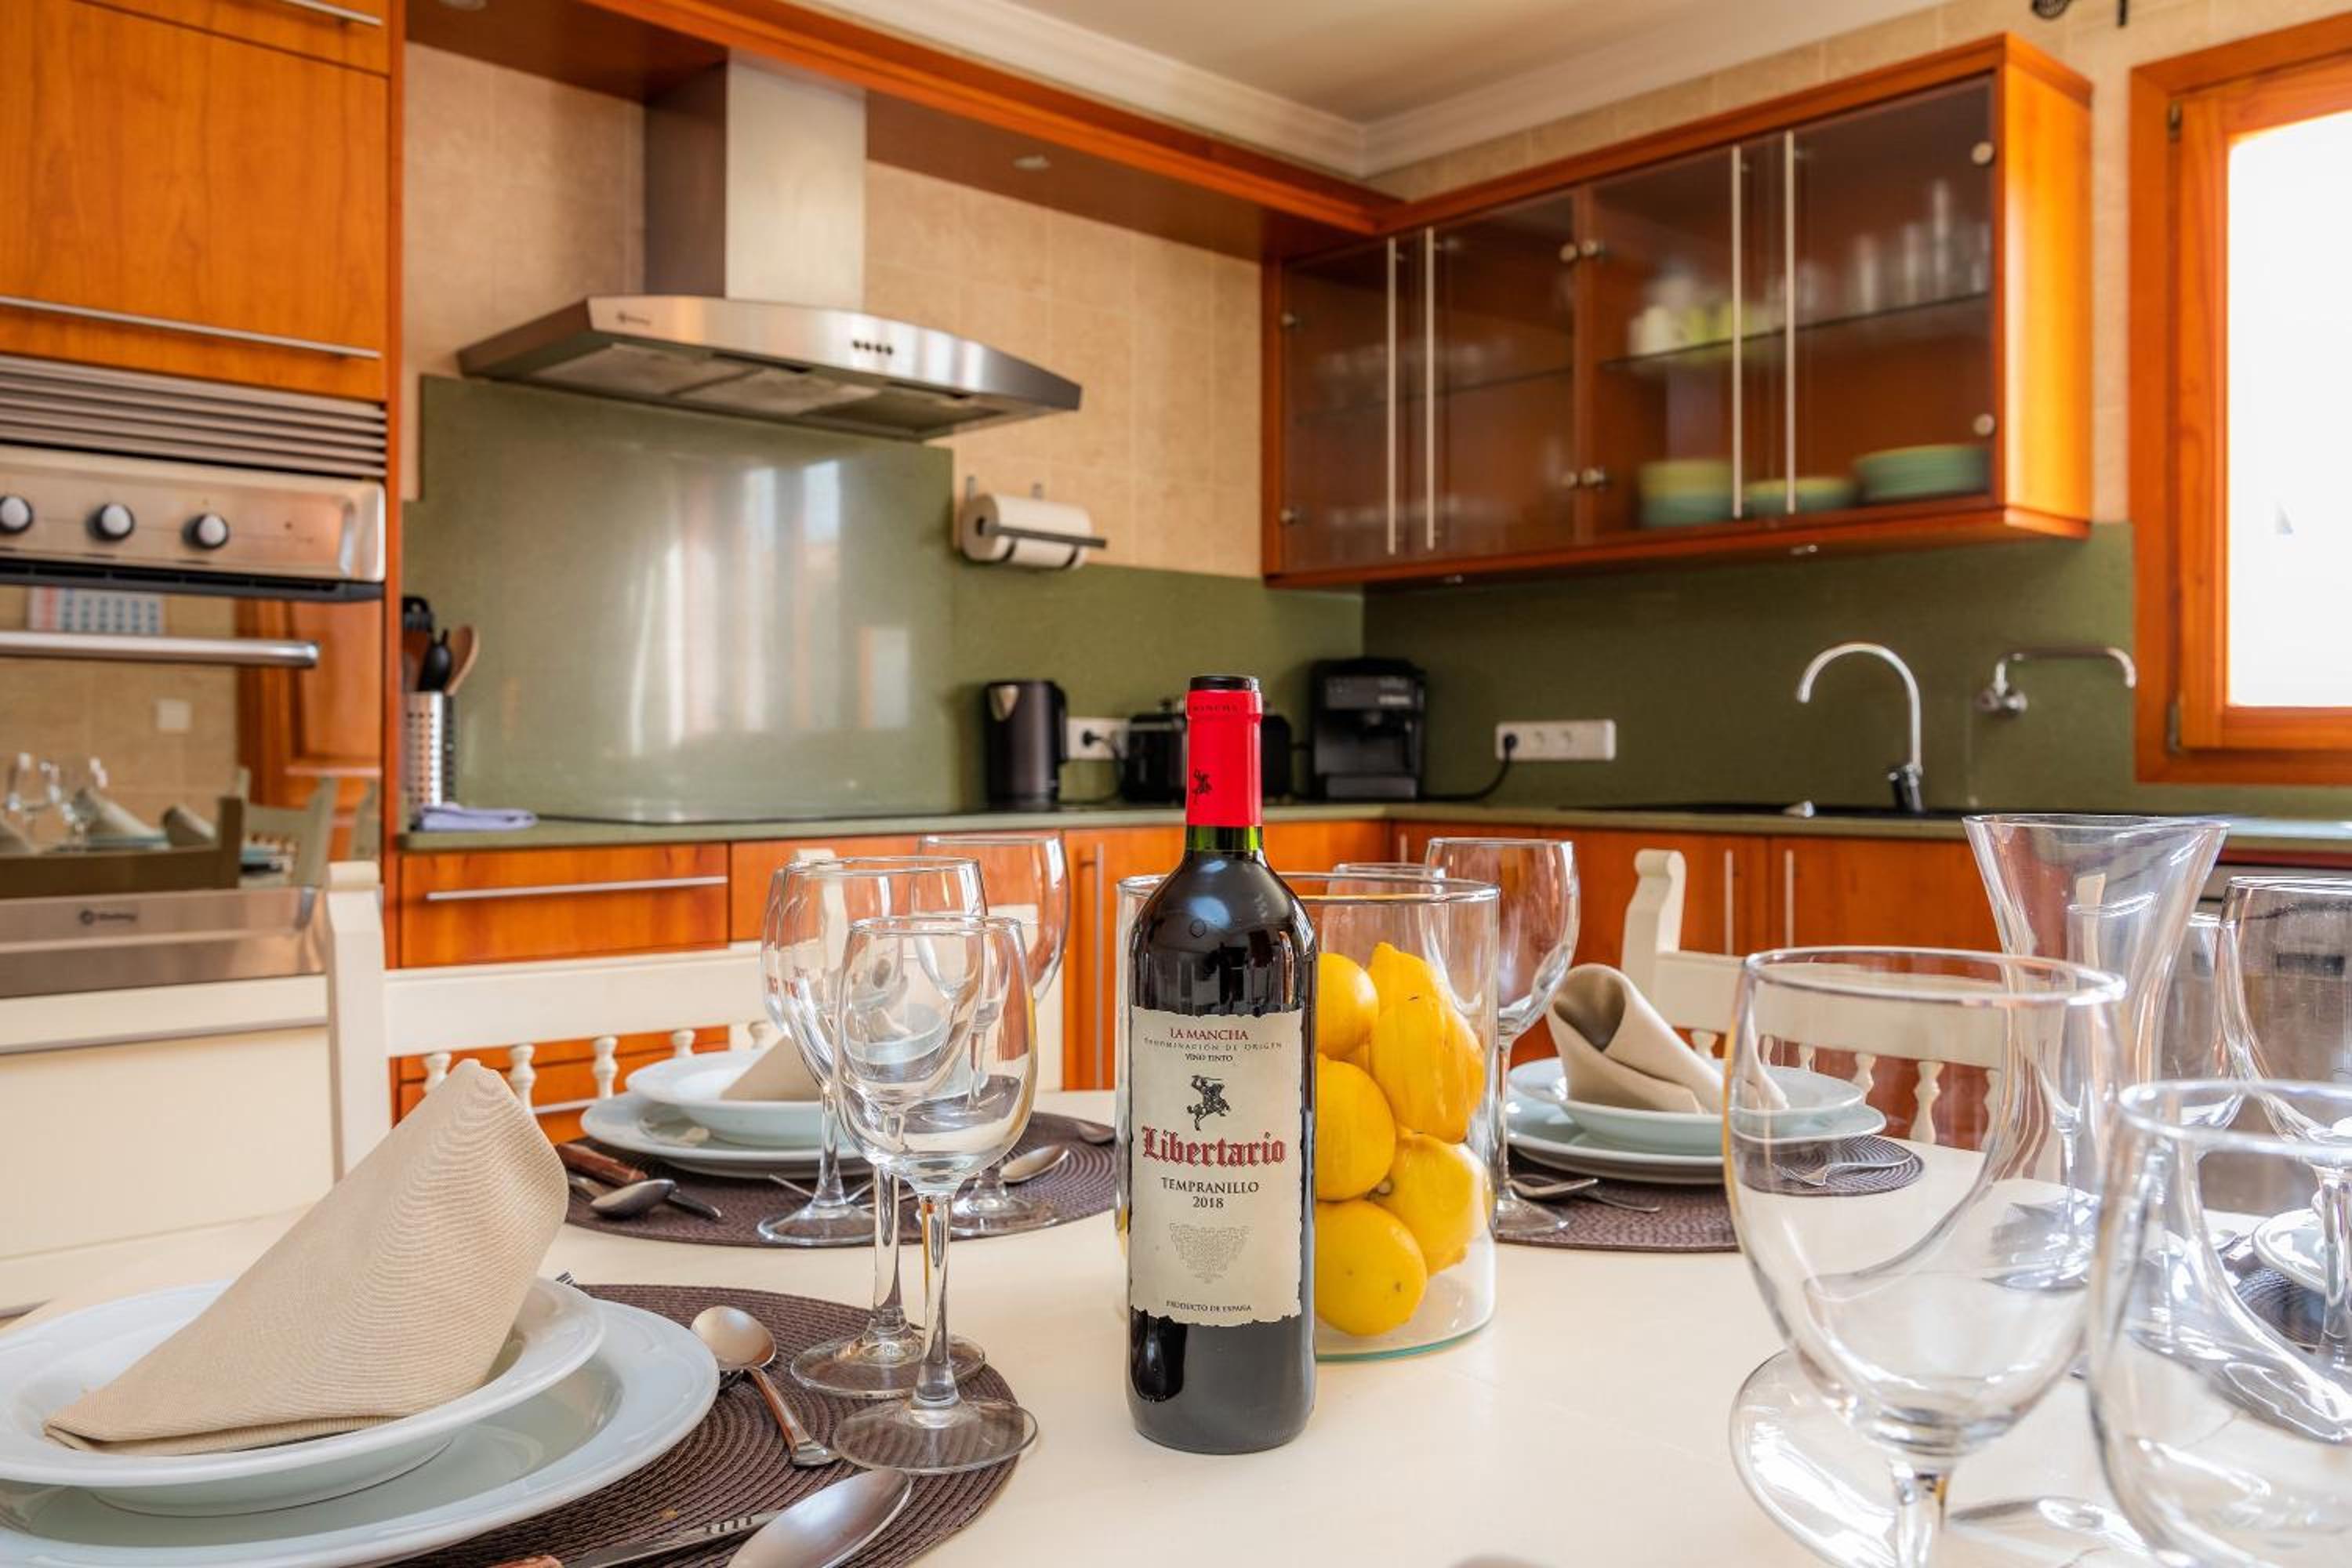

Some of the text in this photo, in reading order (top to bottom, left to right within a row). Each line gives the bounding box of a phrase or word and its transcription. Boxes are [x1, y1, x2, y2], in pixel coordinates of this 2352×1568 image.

[1170, 1028, 1249, 1040] LA MANCHA
[1142, 1126, 1287, 1167] Libertario
[1161, 1177, 1259, 1194] TEMPRANILLO
[1192, 1196, 1225, 1209] 2018
[1166, 1301, 1208, 1312] PRODUCTO
